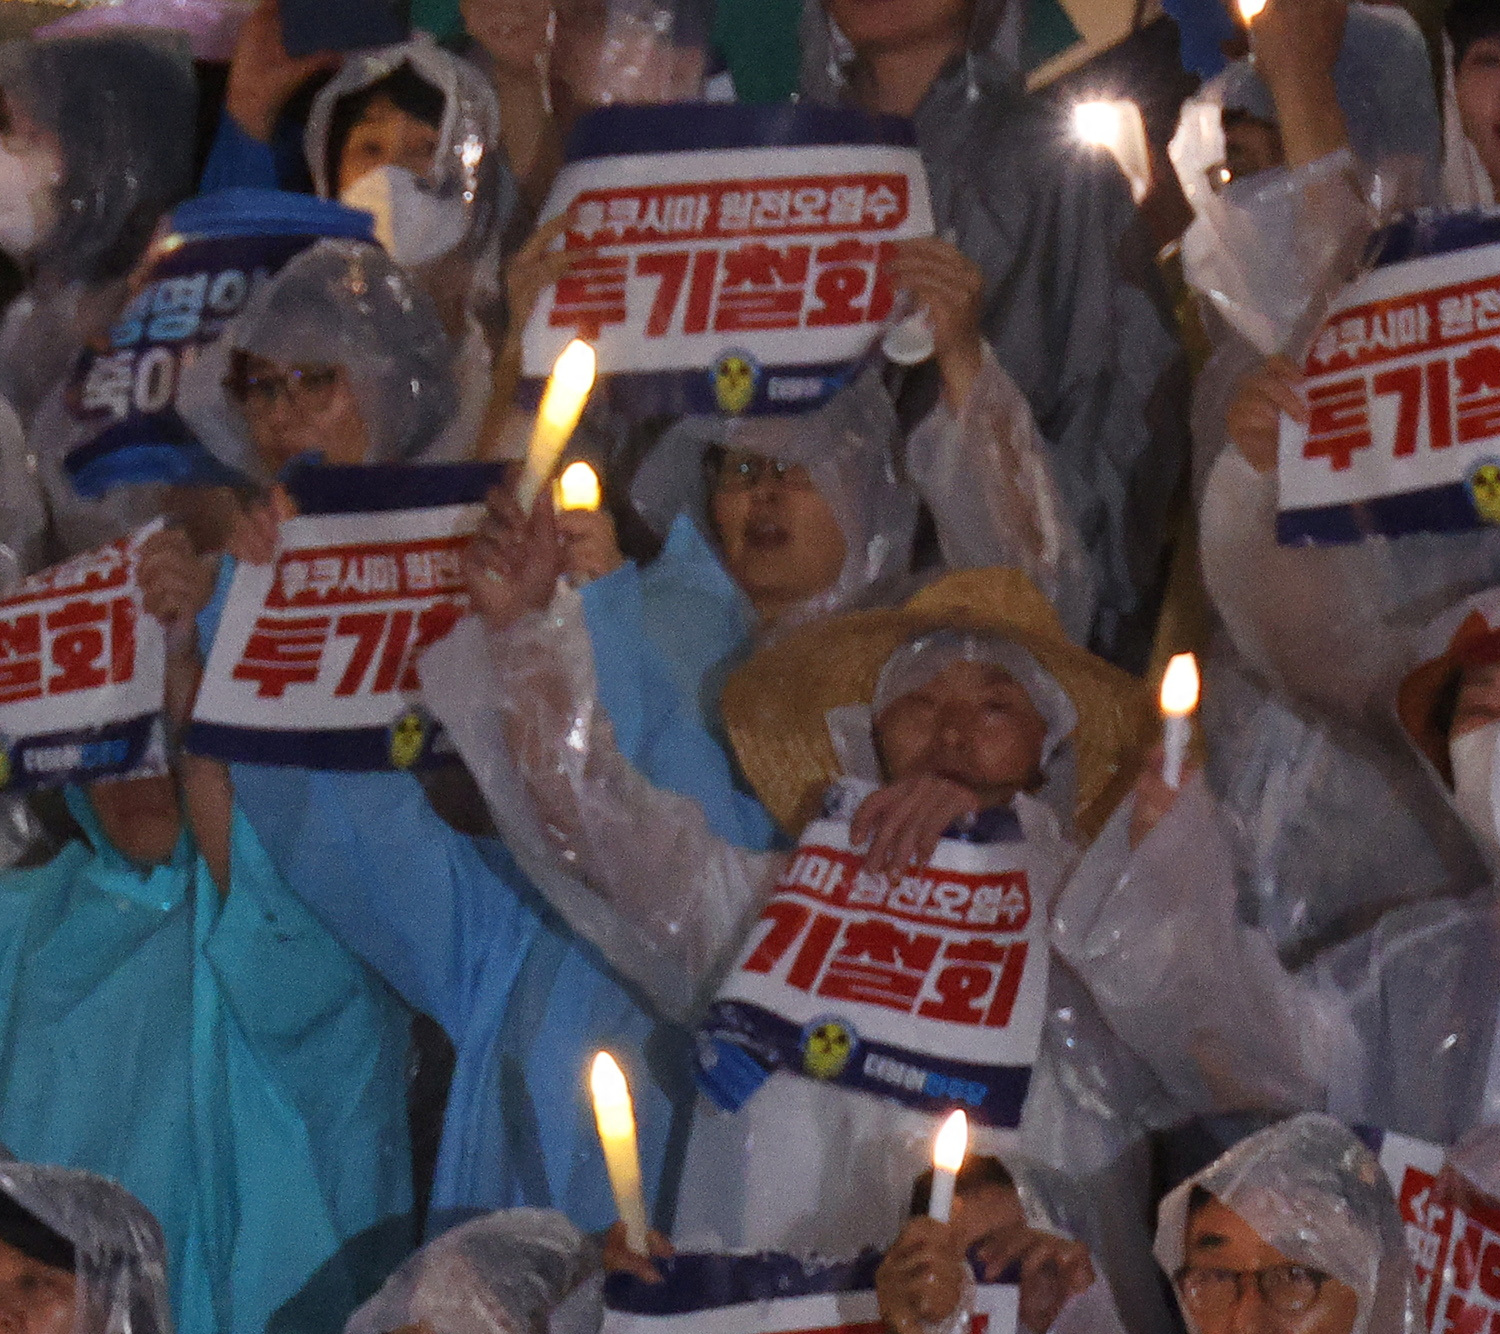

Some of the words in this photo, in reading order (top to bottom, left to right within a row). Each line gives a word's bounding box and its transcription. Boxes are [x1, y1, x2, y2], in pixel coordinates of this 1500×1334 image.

[717, 185, 900, 231] 원전오염수
[548, 239, 900, 340] 투기철회
[743, 903, 1030, 1028] 기철회
